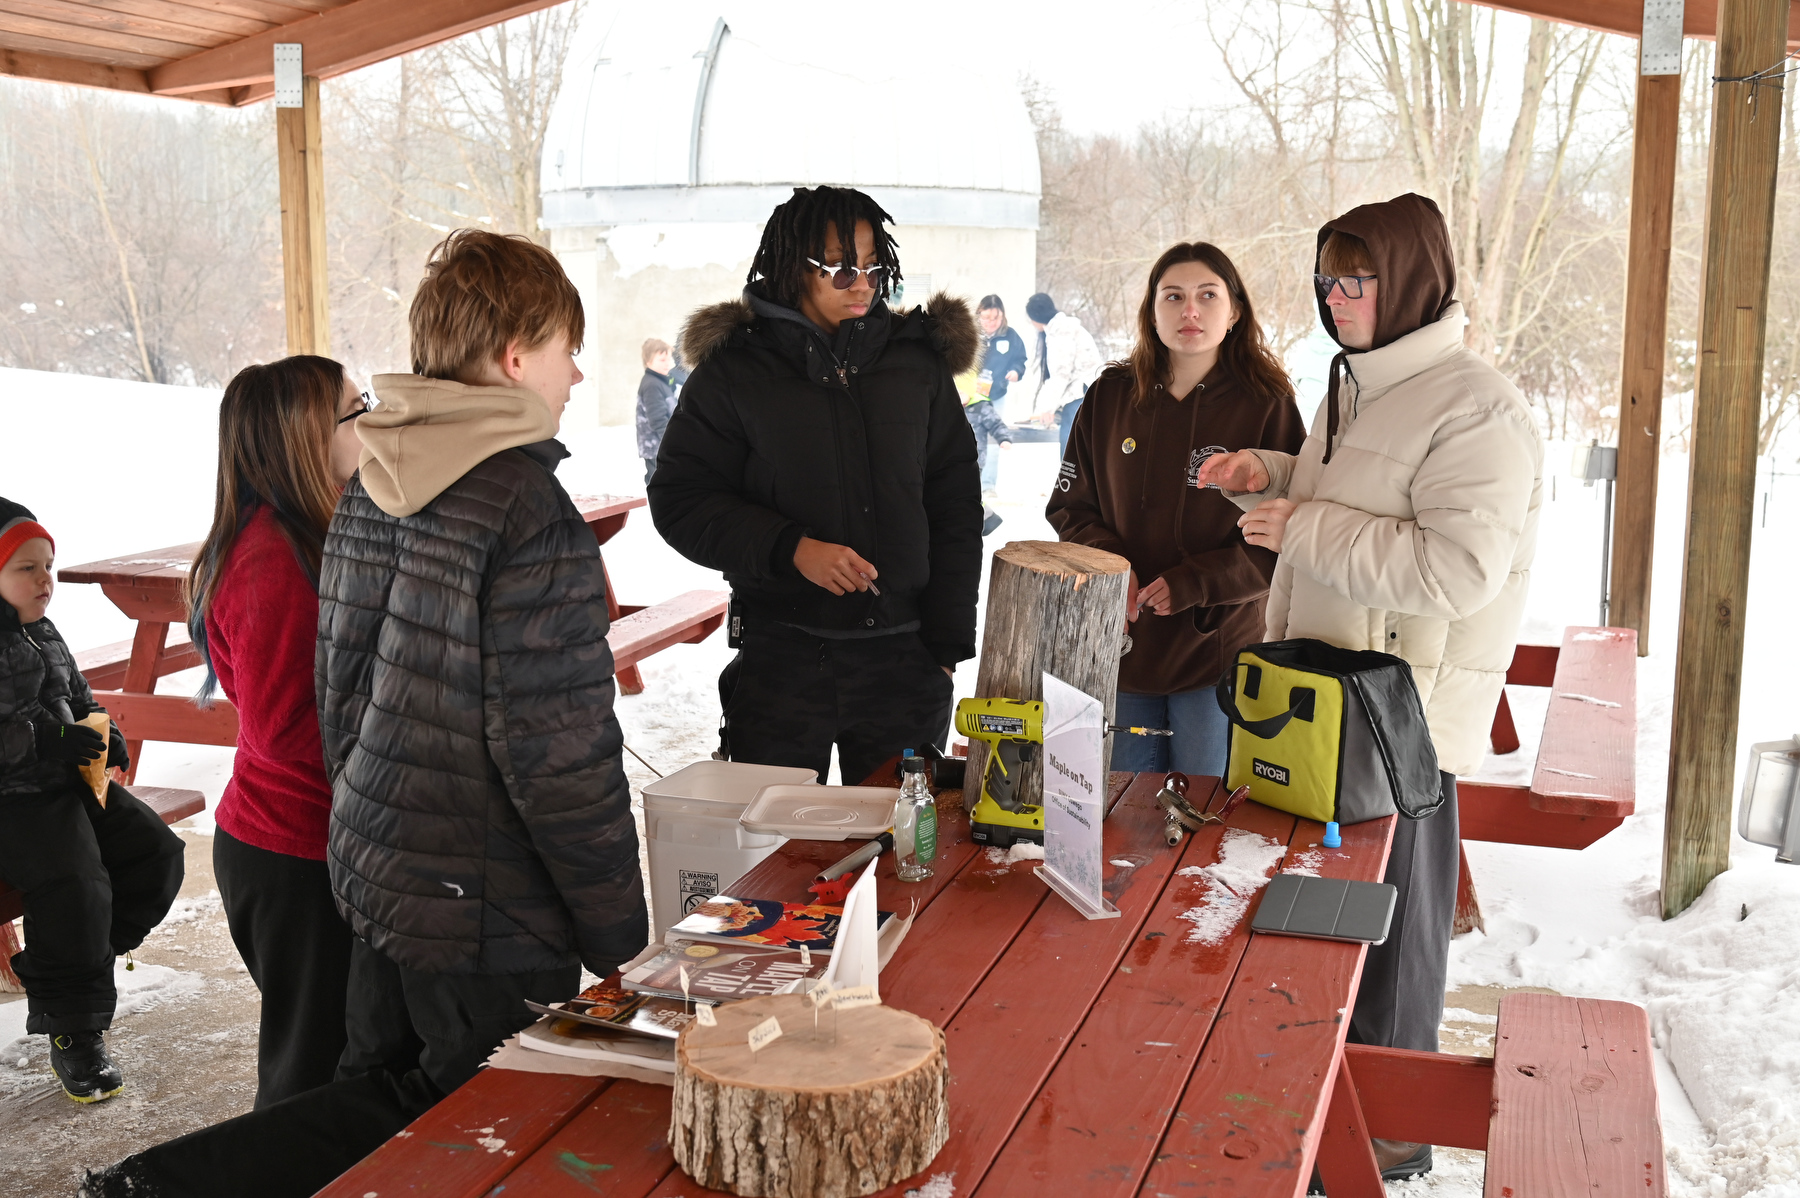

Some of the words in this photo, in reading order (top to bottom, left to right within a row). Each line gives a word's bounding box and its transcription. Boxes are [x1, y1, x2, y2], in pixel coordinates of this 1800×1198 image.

[1049, 753, 1070, 777] Maple
[1070, 771, 1079, 784] on
[1080, 773, 1093, 795] Tap
[1255, 761, 1287, 783] RYOBI
[1051, 795, 1063, 809] Office
[1066, 806, 1091, 830] Sustainability
[687, 872, 717, 881] WARNING
[731, 960, 757, 973] ON
[695, 972, 752, 993] TAP
[739, 961, 815, 995] MAPLE
